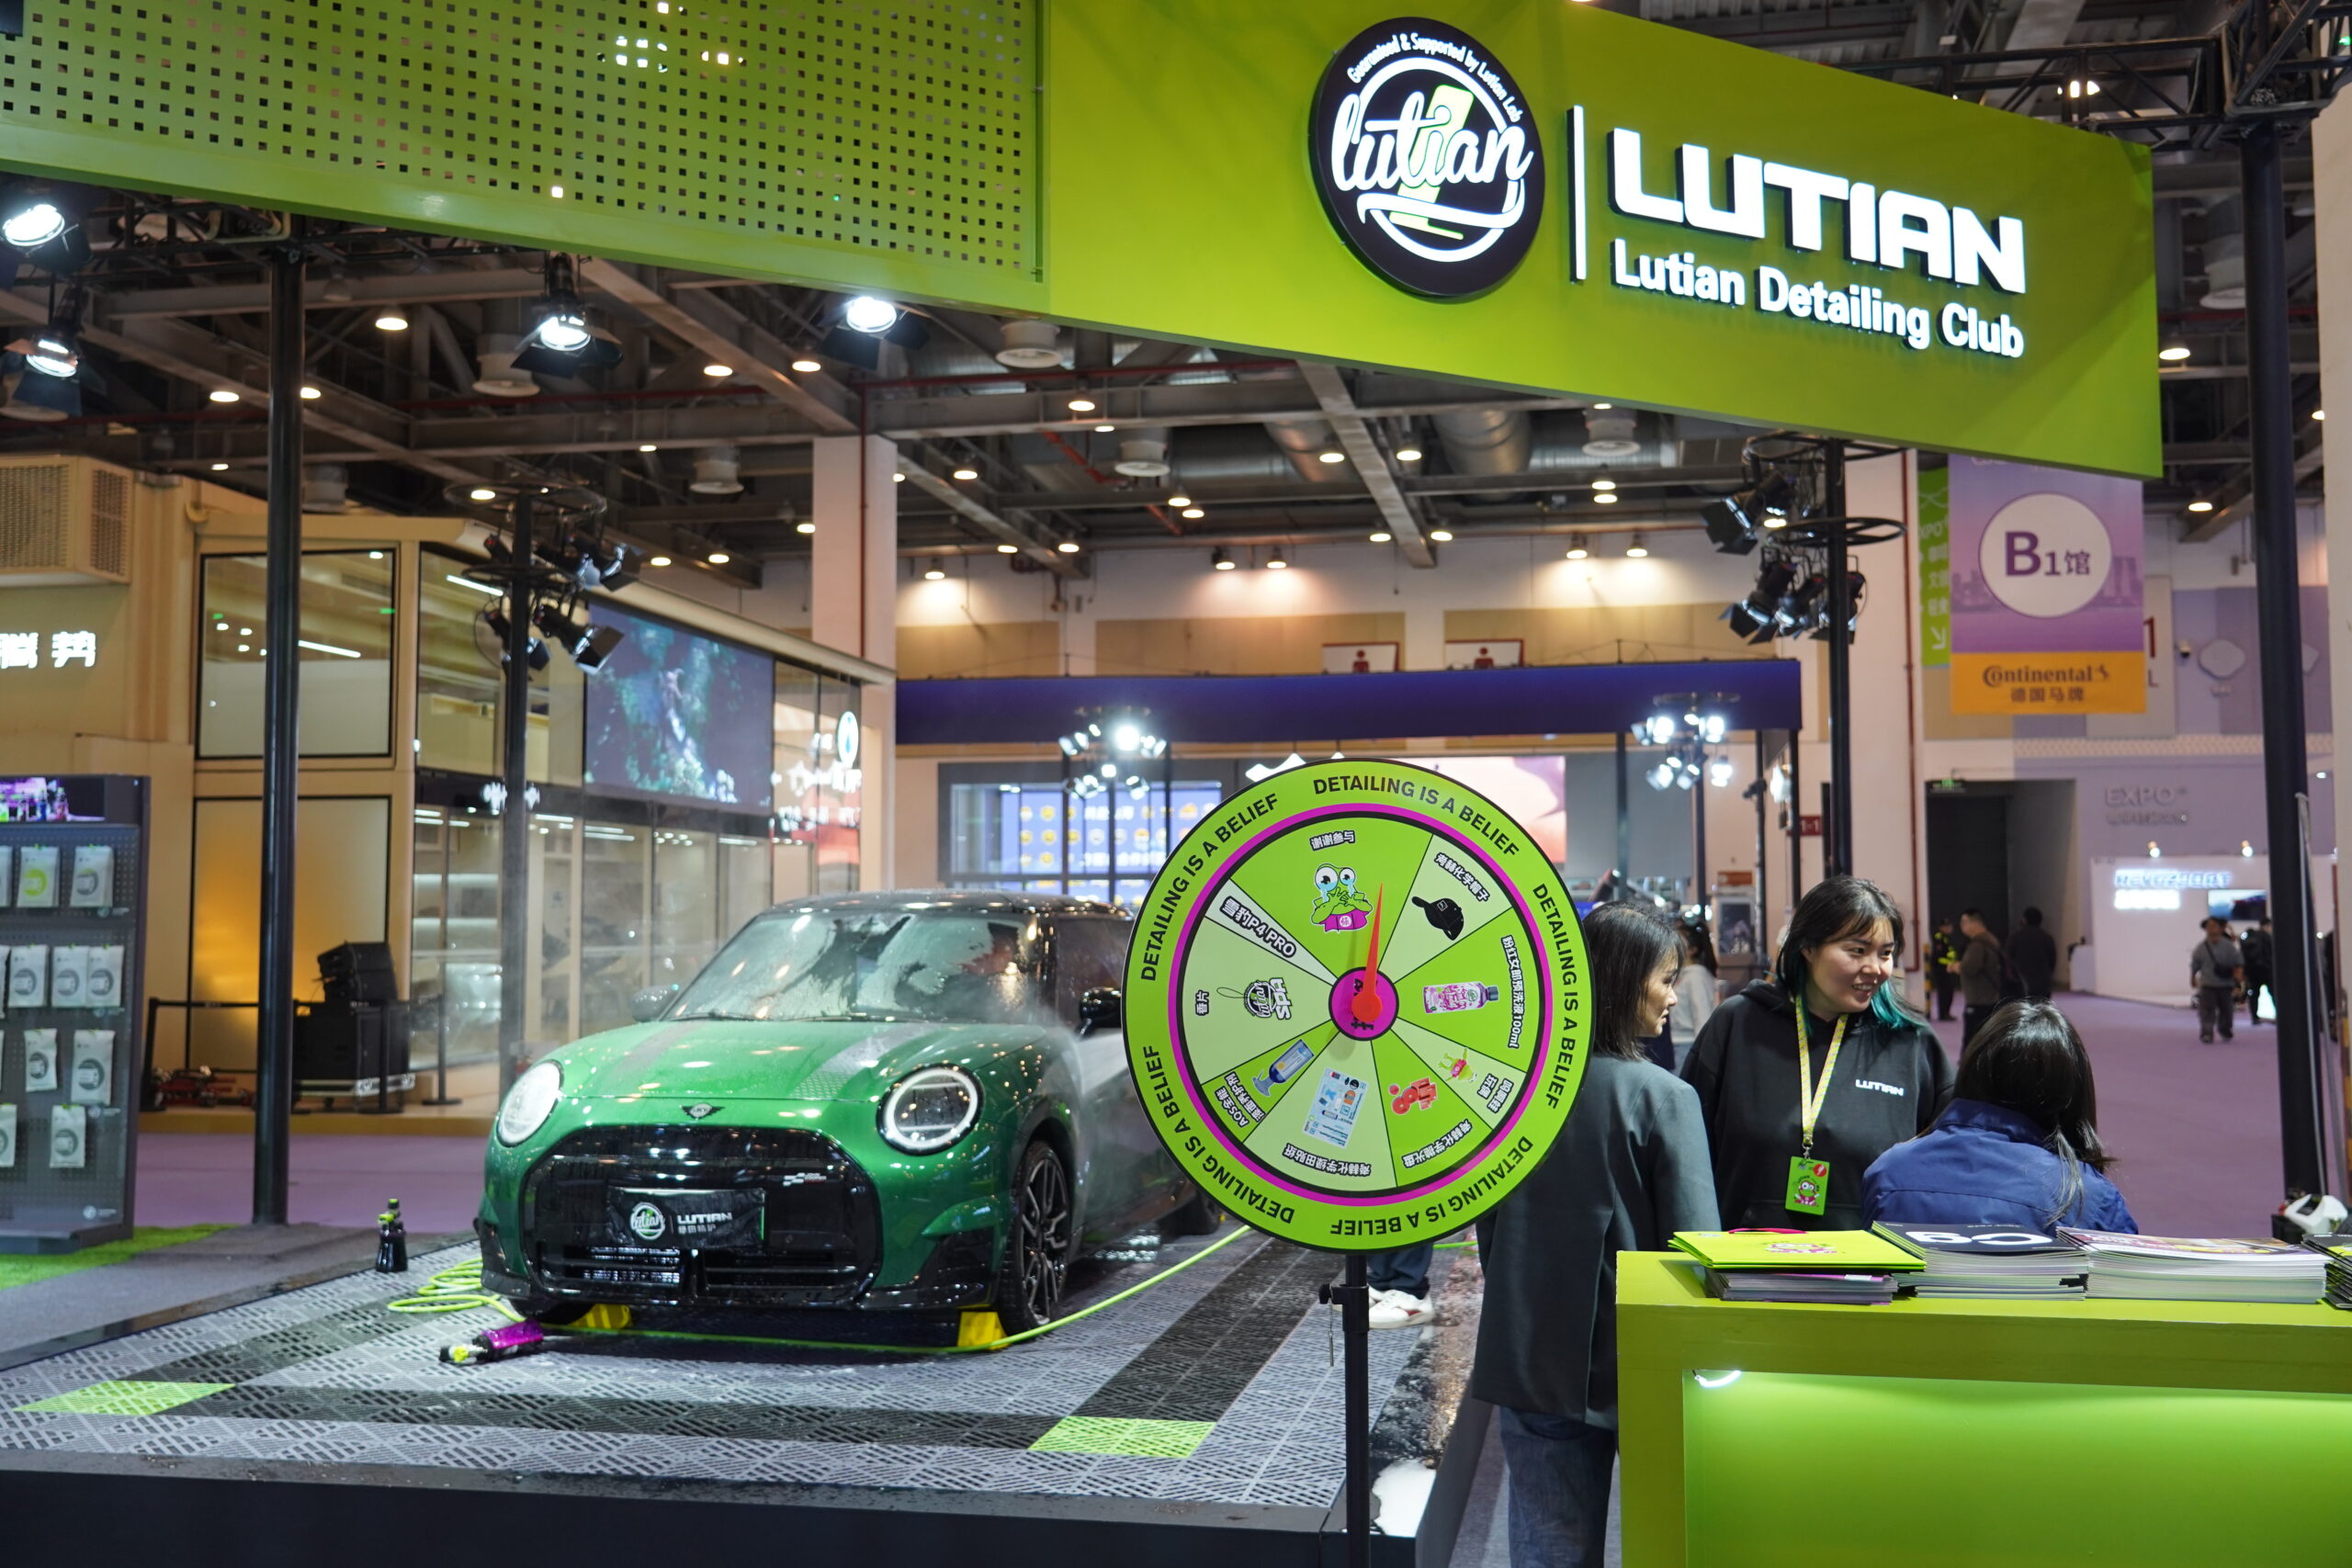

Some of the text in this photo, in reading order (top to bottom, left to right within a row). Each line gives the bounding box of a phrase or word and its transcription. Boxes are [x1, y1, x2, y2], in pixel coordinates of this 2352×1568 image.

[1400, 33, 1411, 50] &
[1410, 32, 1469, 62] Supported
[1465, 51, 1480, 73] by
[1476, 62, 1507, 100] Lutian
[1503, 96, 1523, 122] Lab
[1331, 91, 1533, 191] lutian
[1613, 127, 2027, 294] LUTIAN
[1614, 238, 2025, 357] Lutian Detailing Club
[1983, 664, 2092, 688] Continental
[1309, 830, 1355, 852] 谢谢参与
[1313, 775, 1520, 856] DETAILING IS A BELIEF
[1141, 793, 1279, 981] DETAILING IS A BELIEF
[1434, 852, 1490, 902] 考赫化学帽子
[1220, 896, 1296, 958] 雪豹P4 PRO
[1195, 989, 1210, 1017] 香片
[1269, 977, 1292, 1020] SPA
[1532, 884, 1578, 1109] DETAILING IS A BELIEF
[1477, 1073, 1498, 1100] 玩偶
[1855, 1078, 1905, 1096] LUTIAN
[1143, 1045, 1295, 1224] DETAILING IS A BELIEF
[1282, 1143, 1372, 1177] 考赫化学绿田贴纸
[1402, 1118, 1473, 1168] 考赫化学抛光盘
[1330, 1136, 1533, 1235] DETAILING IS A BELIEF
[676, 1212, 733, 1224] LUTIAN
